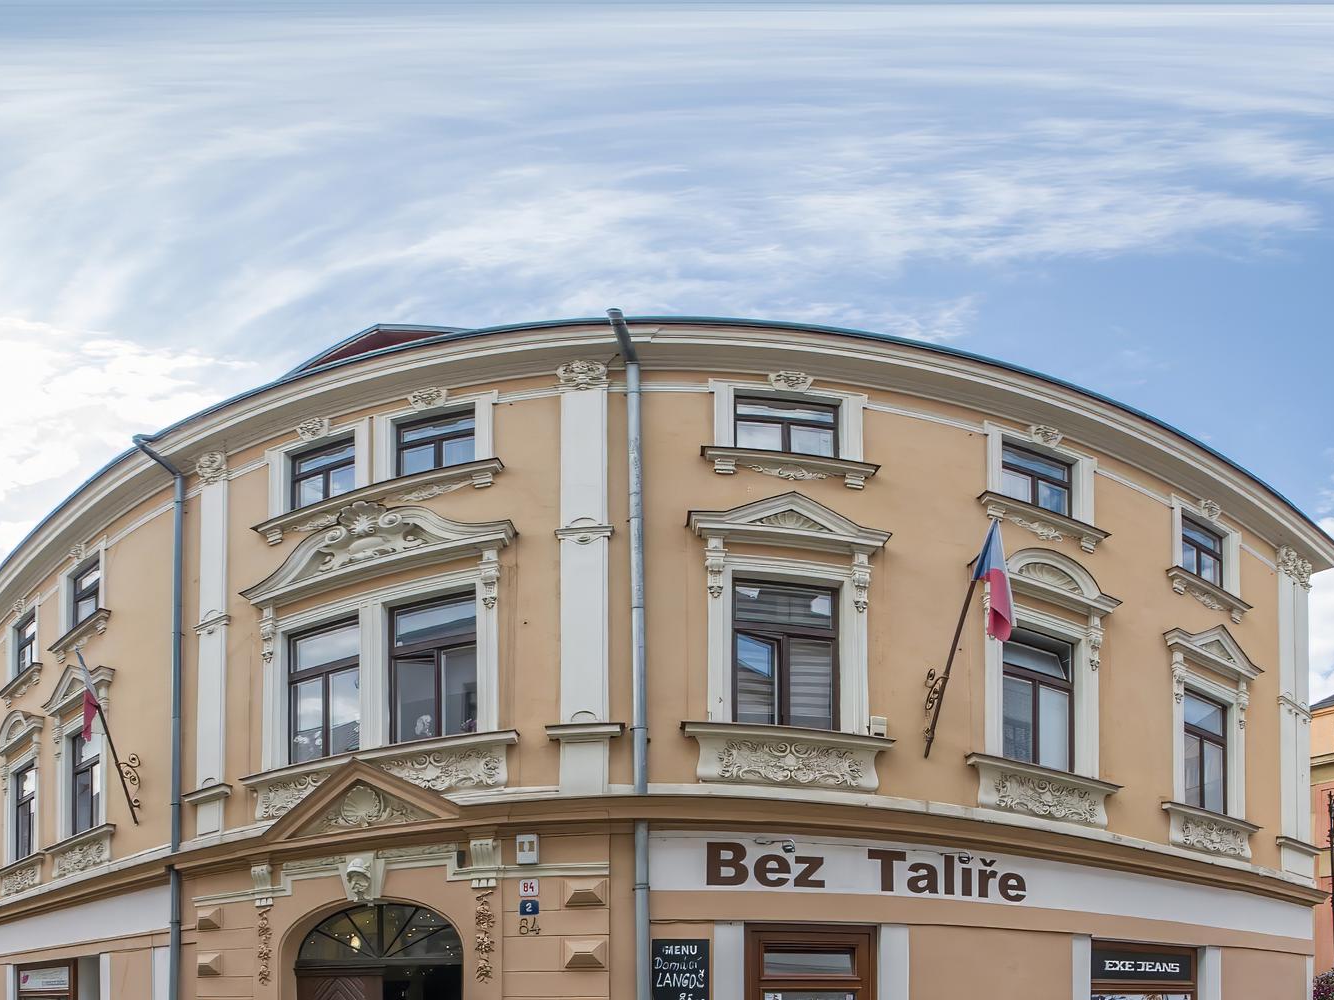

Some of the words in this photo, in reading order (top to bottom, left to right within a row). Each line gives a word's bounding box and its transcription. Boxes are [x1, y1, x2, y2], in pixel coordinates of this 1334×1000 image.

[706, 841, 826, 888] Bez
[867, 848, 1027, 902] Talíře
[523, 882, 534, 892] 84
[525, 902, 533, 912] 2
[519, 917, 541, 935] 84
[663, 945, 697, 955] MENU
[654, 956, 703, 971] Domácí
[1104, 960, 1135, 972] EXE
[1136, 961, 1180, 973] JEANS
[656, 969, 705, 989] LANGOŠ
